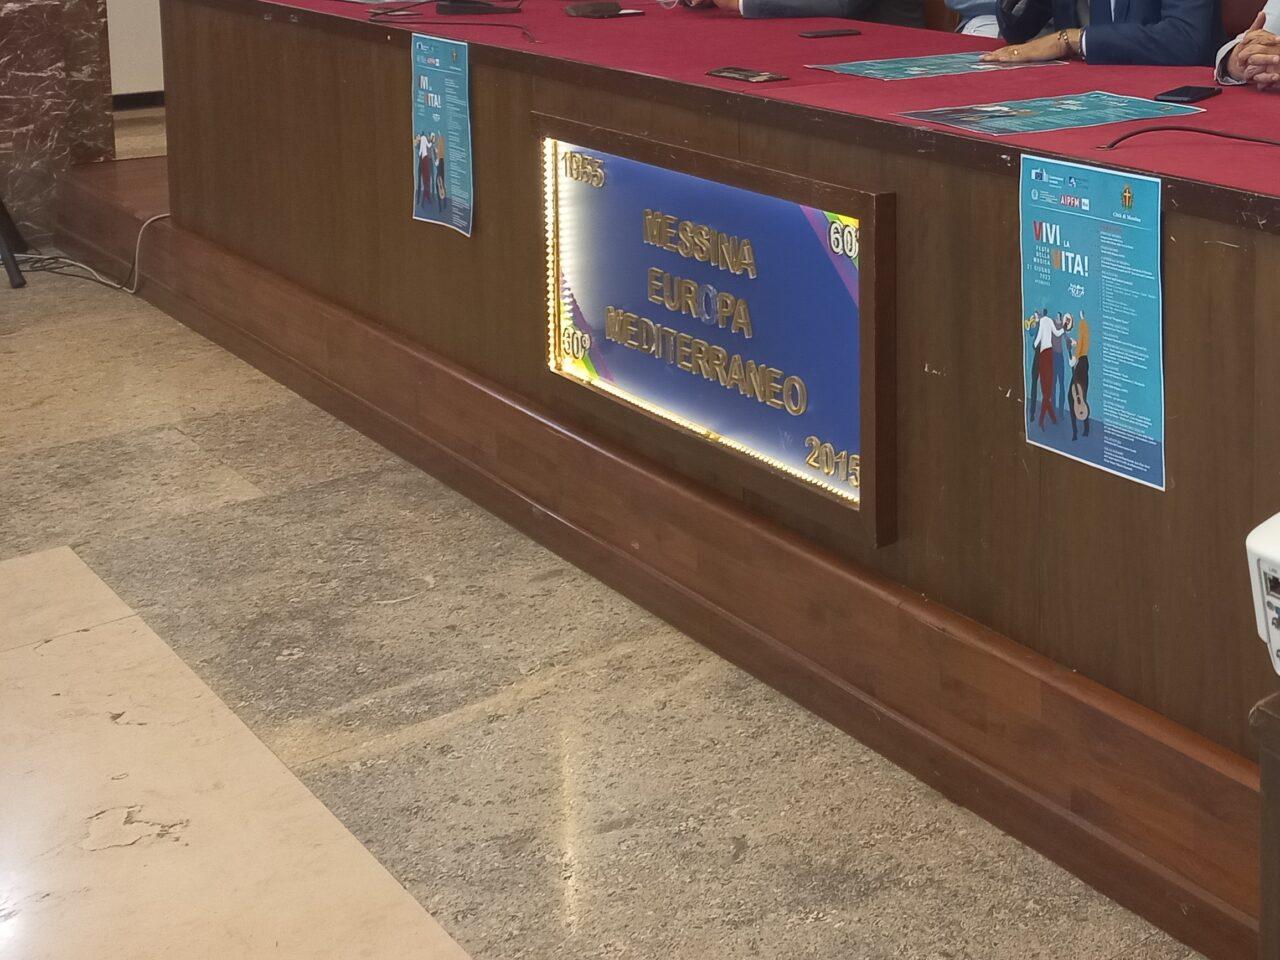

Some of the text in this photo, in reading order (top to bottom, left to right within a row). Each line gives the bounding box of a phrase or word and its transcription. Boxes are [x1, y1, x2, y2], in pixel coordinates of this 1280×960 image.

[560, 150, 605, 189] 1955
[642, 207, 758, 281] MESSINA
[1032, 220, 1071, 248] VIVI LA
[646, 265, 754, 340] EUROPA
[603, 304, 809, 417] MEDITERRANEO
[804, 435, 860, 488] 2015
